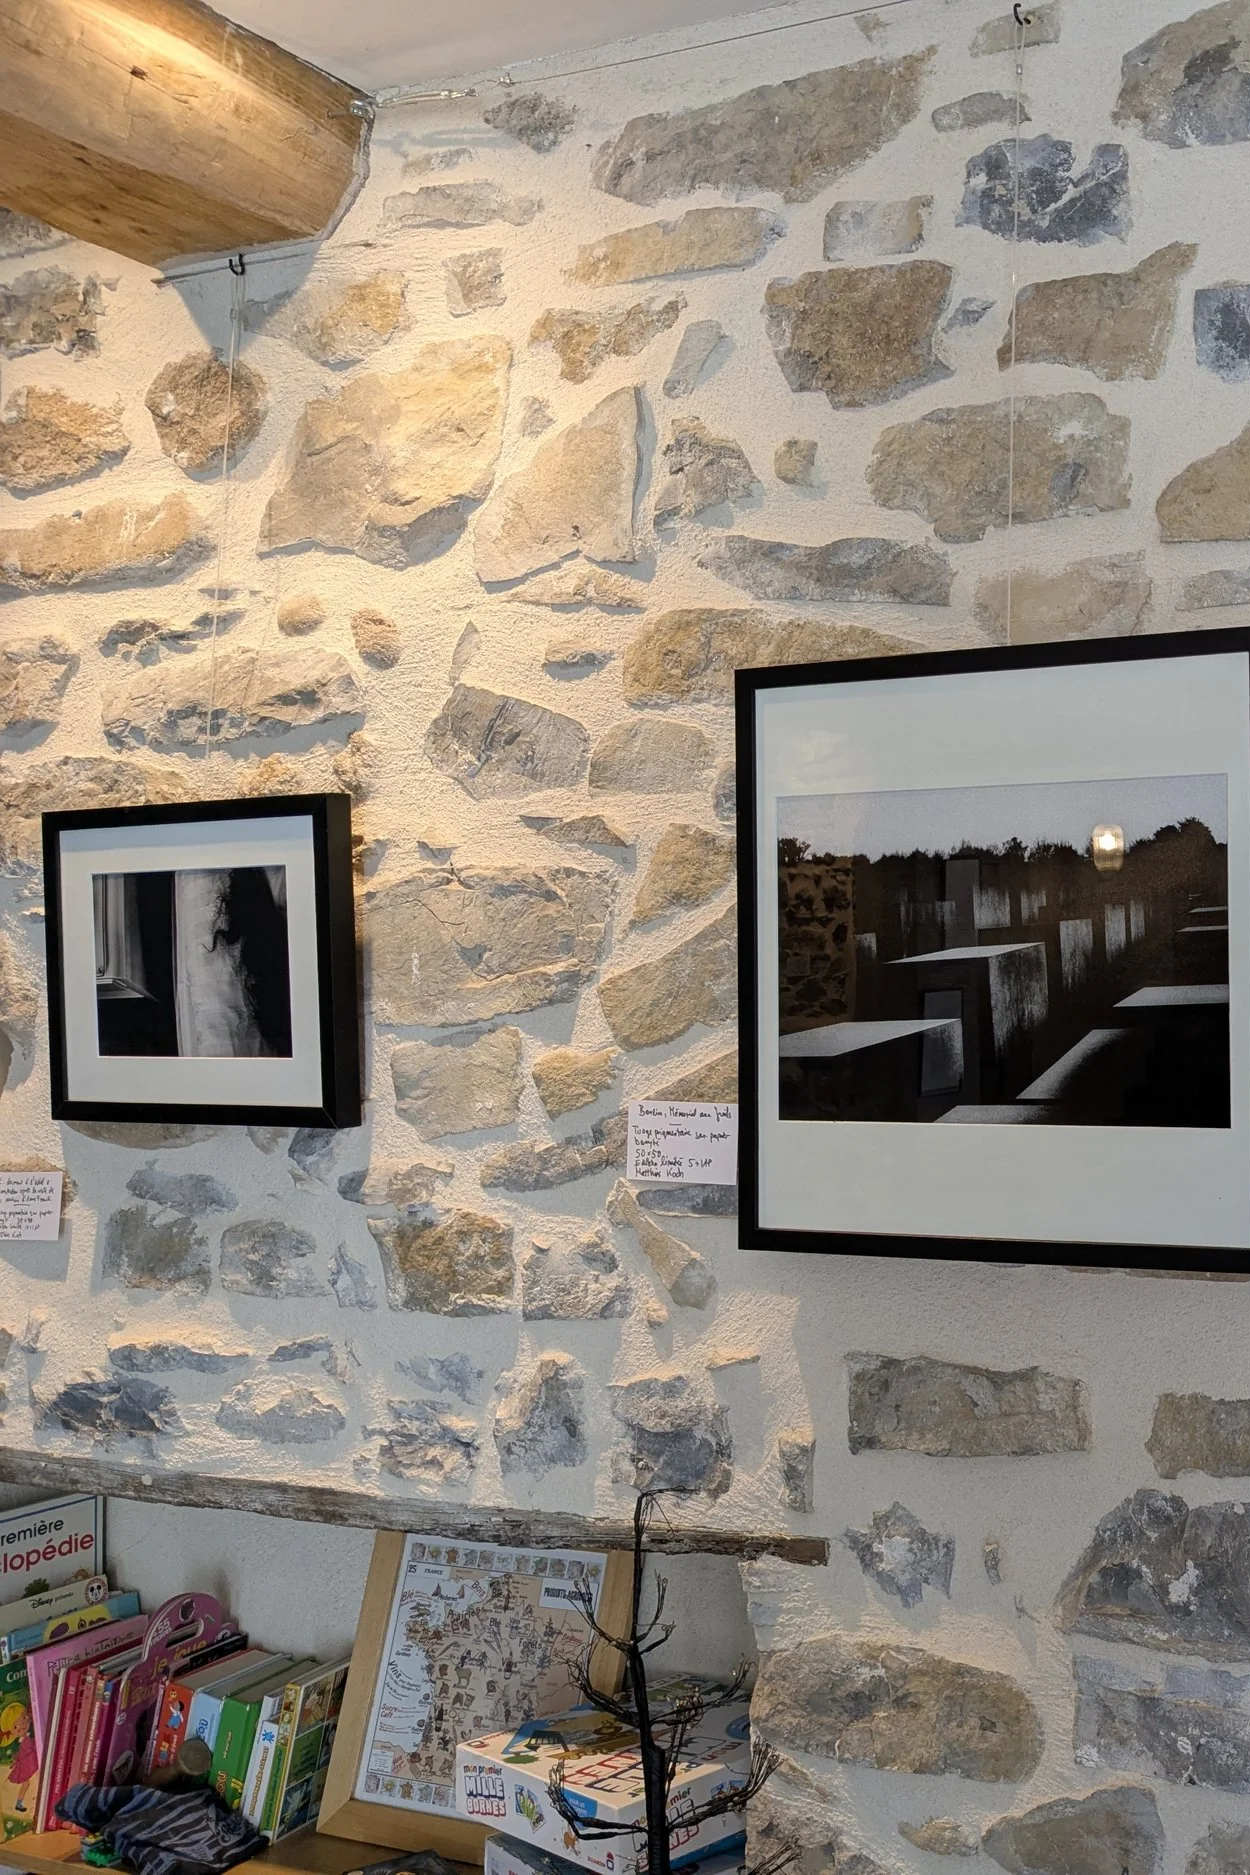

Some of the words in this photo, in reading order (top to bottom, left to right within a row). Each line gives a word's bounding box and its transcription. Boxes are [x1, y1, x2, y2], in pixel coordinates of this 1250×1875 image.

[0, 1532, 95, 1574] lopédie
[463, 1765, 477, 1774] mon
[478, 1765, 502, 1775] premier
[464, 1775, 505, 1800] MILLE
[466, 1798, 506, 1817] BORNES
